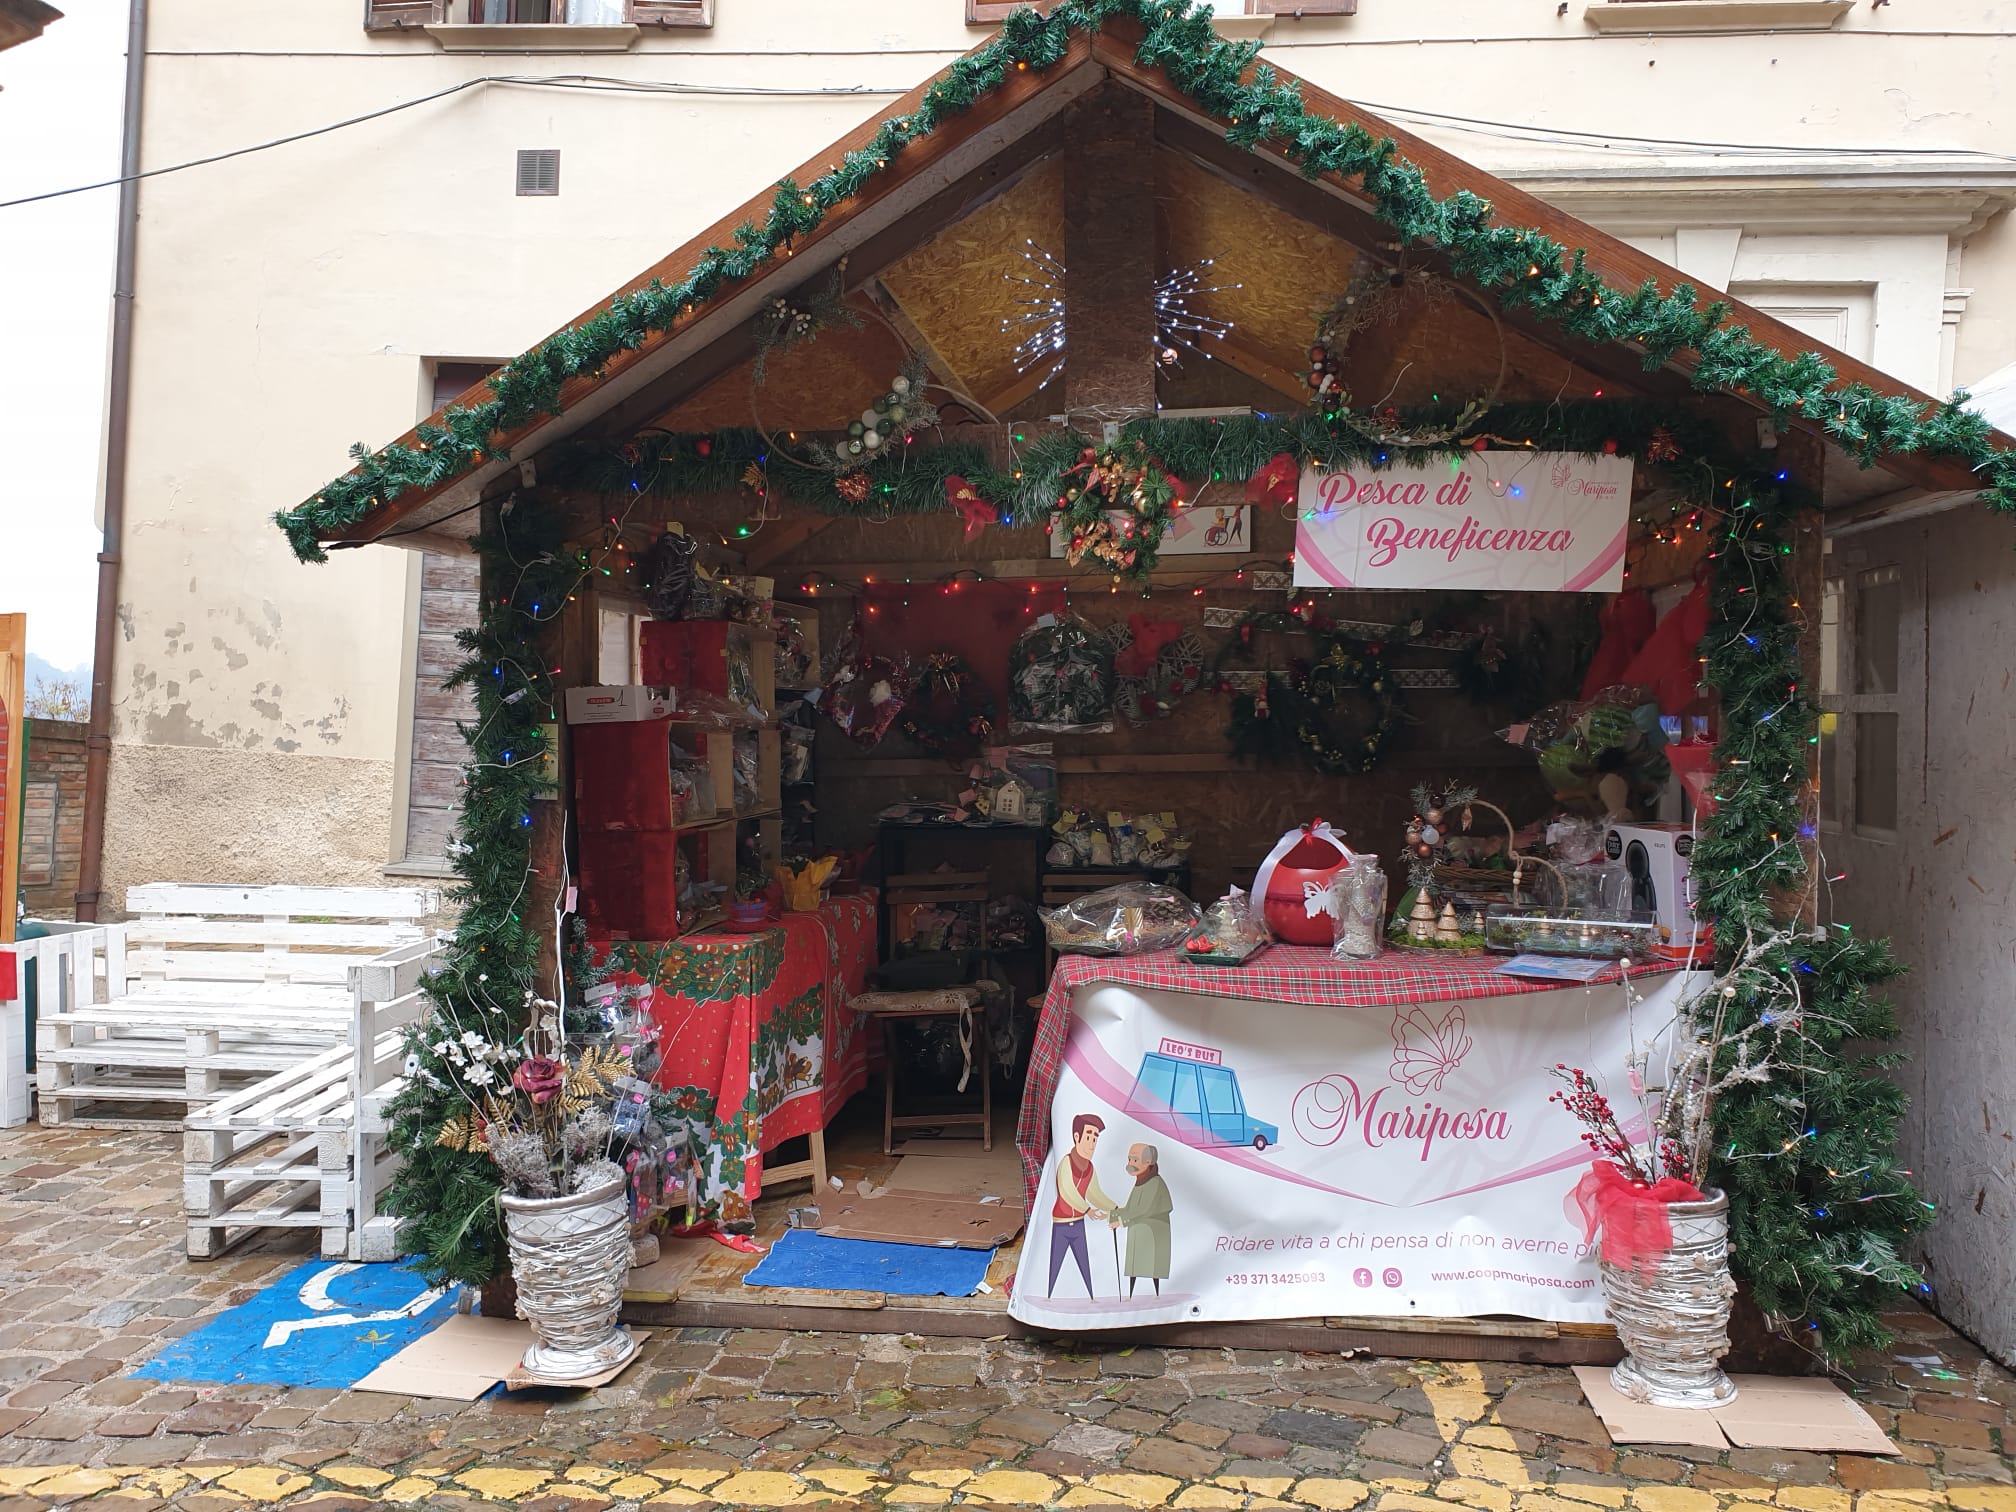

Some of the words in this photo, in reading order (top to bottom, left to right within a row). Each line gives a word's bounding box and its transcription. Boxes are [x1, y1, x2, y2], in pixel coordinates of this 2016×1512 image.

[1318, 471, 1428, 514] Pesca
[1435, 470, 1472, 506] di
[1567, 479, 1617, 499] Mariposa
[1366, 515, 1575, 568] Beneficenza
[1166, 1043, 1193, 1057] LEO'S
[1195, 1049, 1215, 1062] BUS
[1291, 1073, 1513, 1162] Mariposa
[1216, 1235, 1275, 1252] Ridare
[1281, 1233, 1313, 1250] vita
[1319, 1237, 1330, 1249] a
[1337, 1232, 1366, 1249] chi
[1371, 1234, 1428, 1252] pensa
[1435, 1232, 1453, 1249] di
[1459, 1233, 1496, 1248] non
[1501, 1237, 1569, 1255] averne
[1225, 1274, 1248, 1285] +39
[1250, 1273, 1269, 1285] 371
[1271, 1272, 1326, 1284] 3425093
[1431, 1268, 1595, 1289] www.coopmariposa.com
